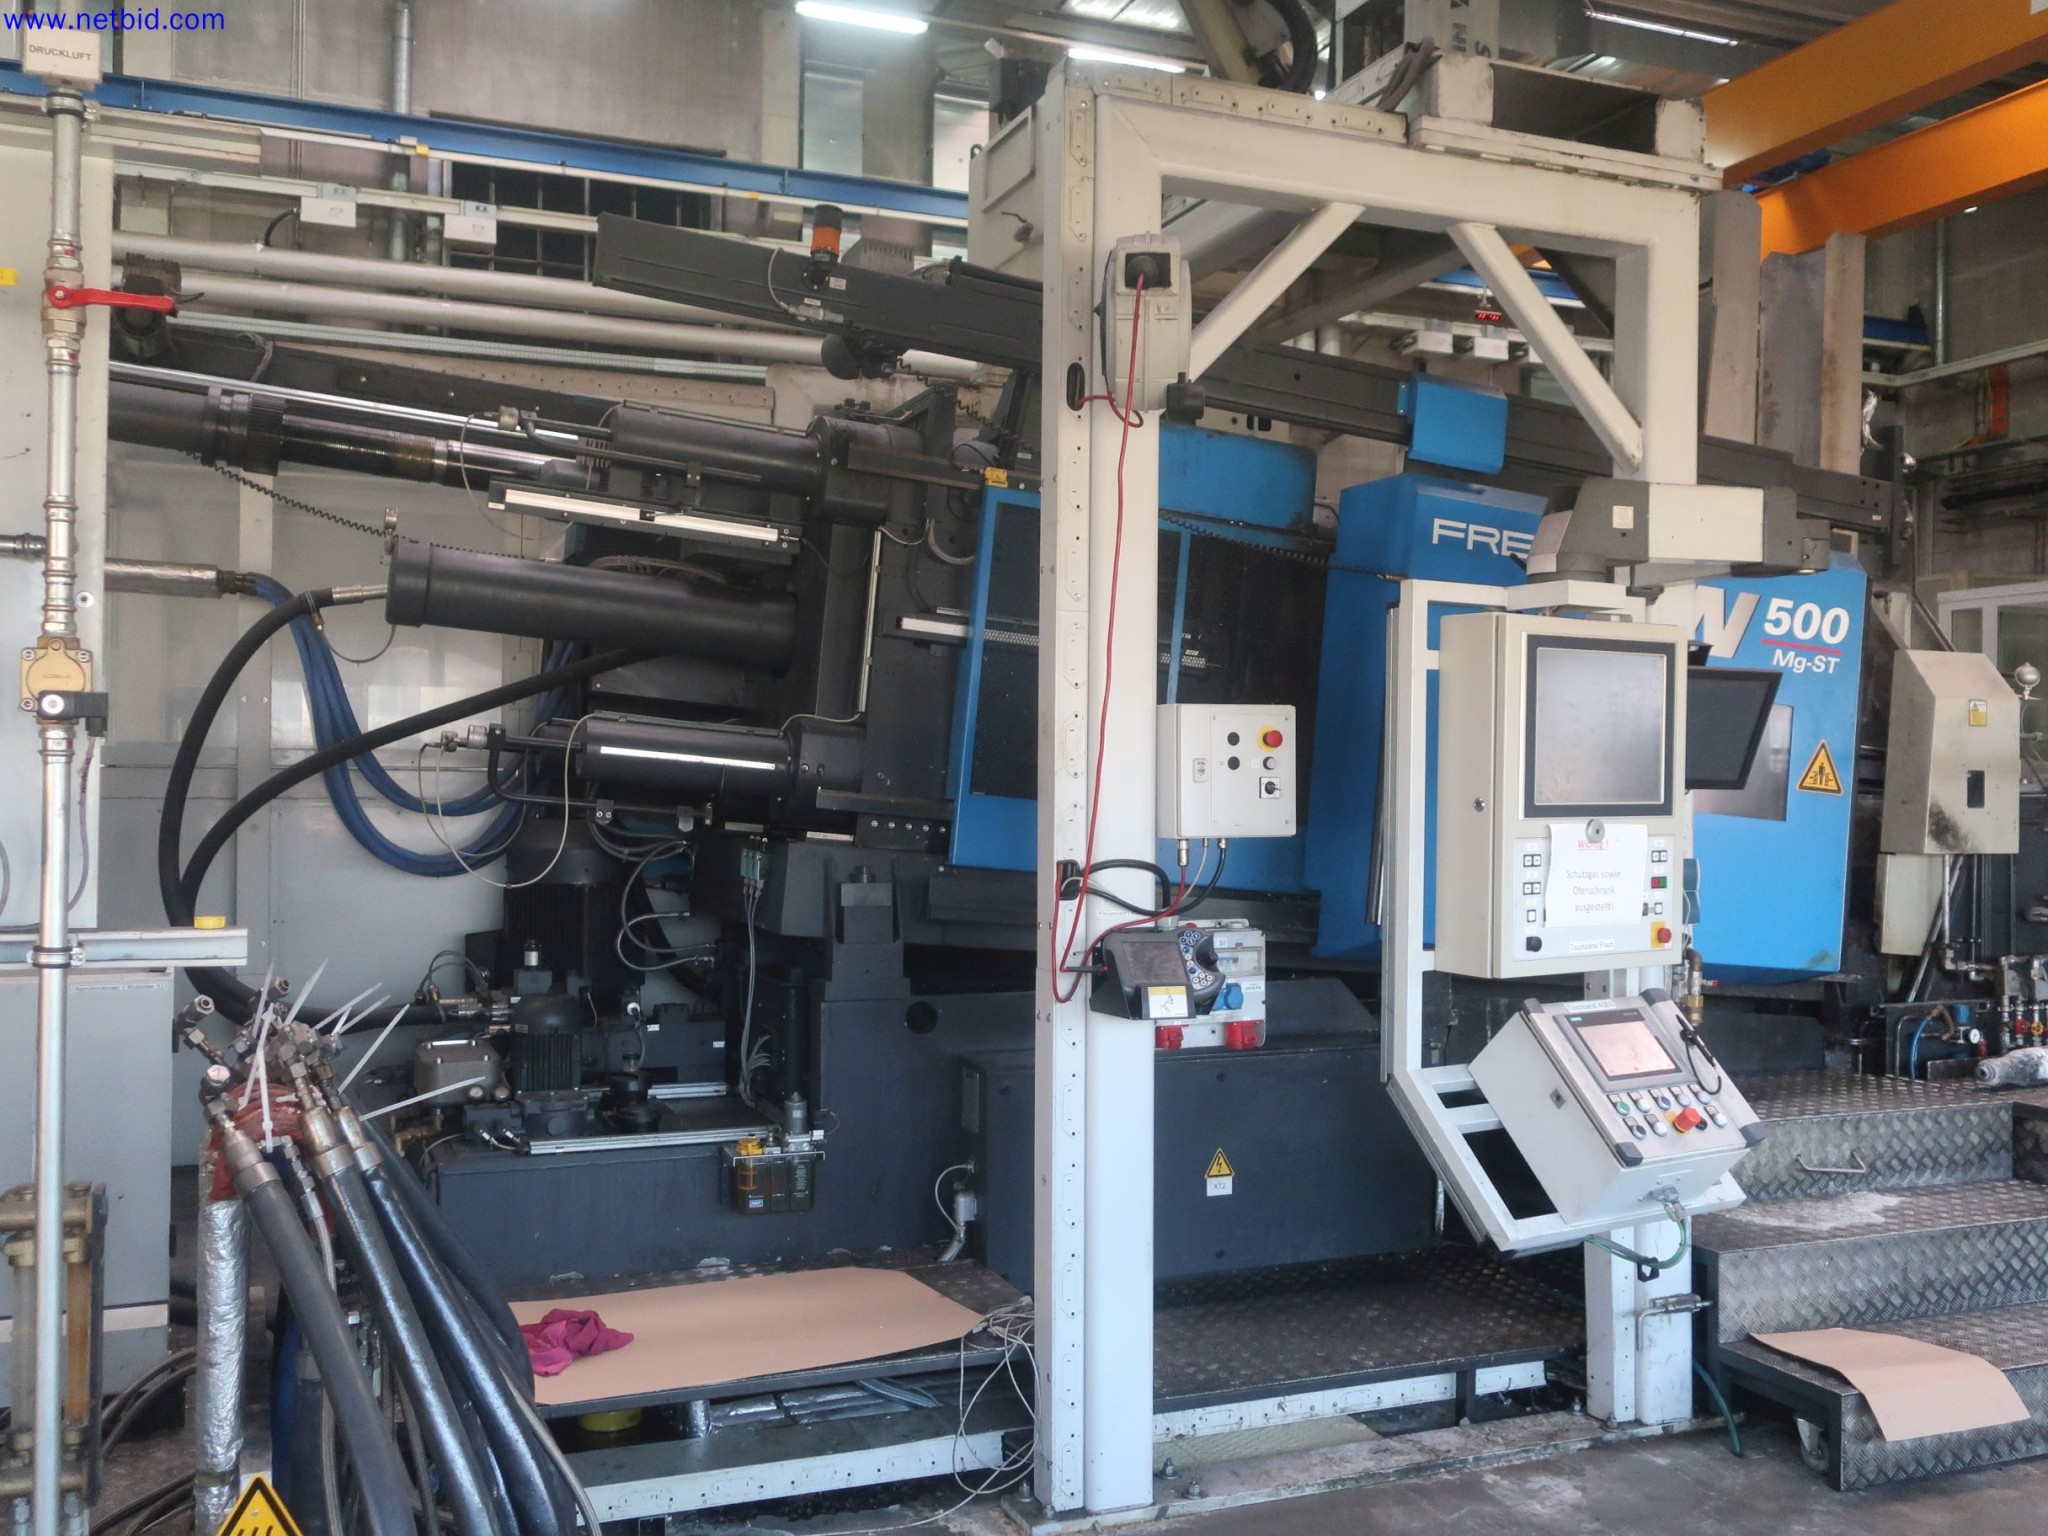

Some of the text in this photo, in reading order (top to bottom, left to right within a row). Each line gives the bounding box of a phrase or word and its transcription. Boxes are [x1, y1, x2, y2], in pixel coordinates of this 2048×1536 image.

[28, 44, 92, 61] DRUCKLUFT
[1764, 597, 1850, 645] 500
[1772, 648, 1841, 674] Mg-ST
[1566, 869, 1621, 881] Schutzgas sowie
[1572, 885, 1616, 896] Ofenschrank
